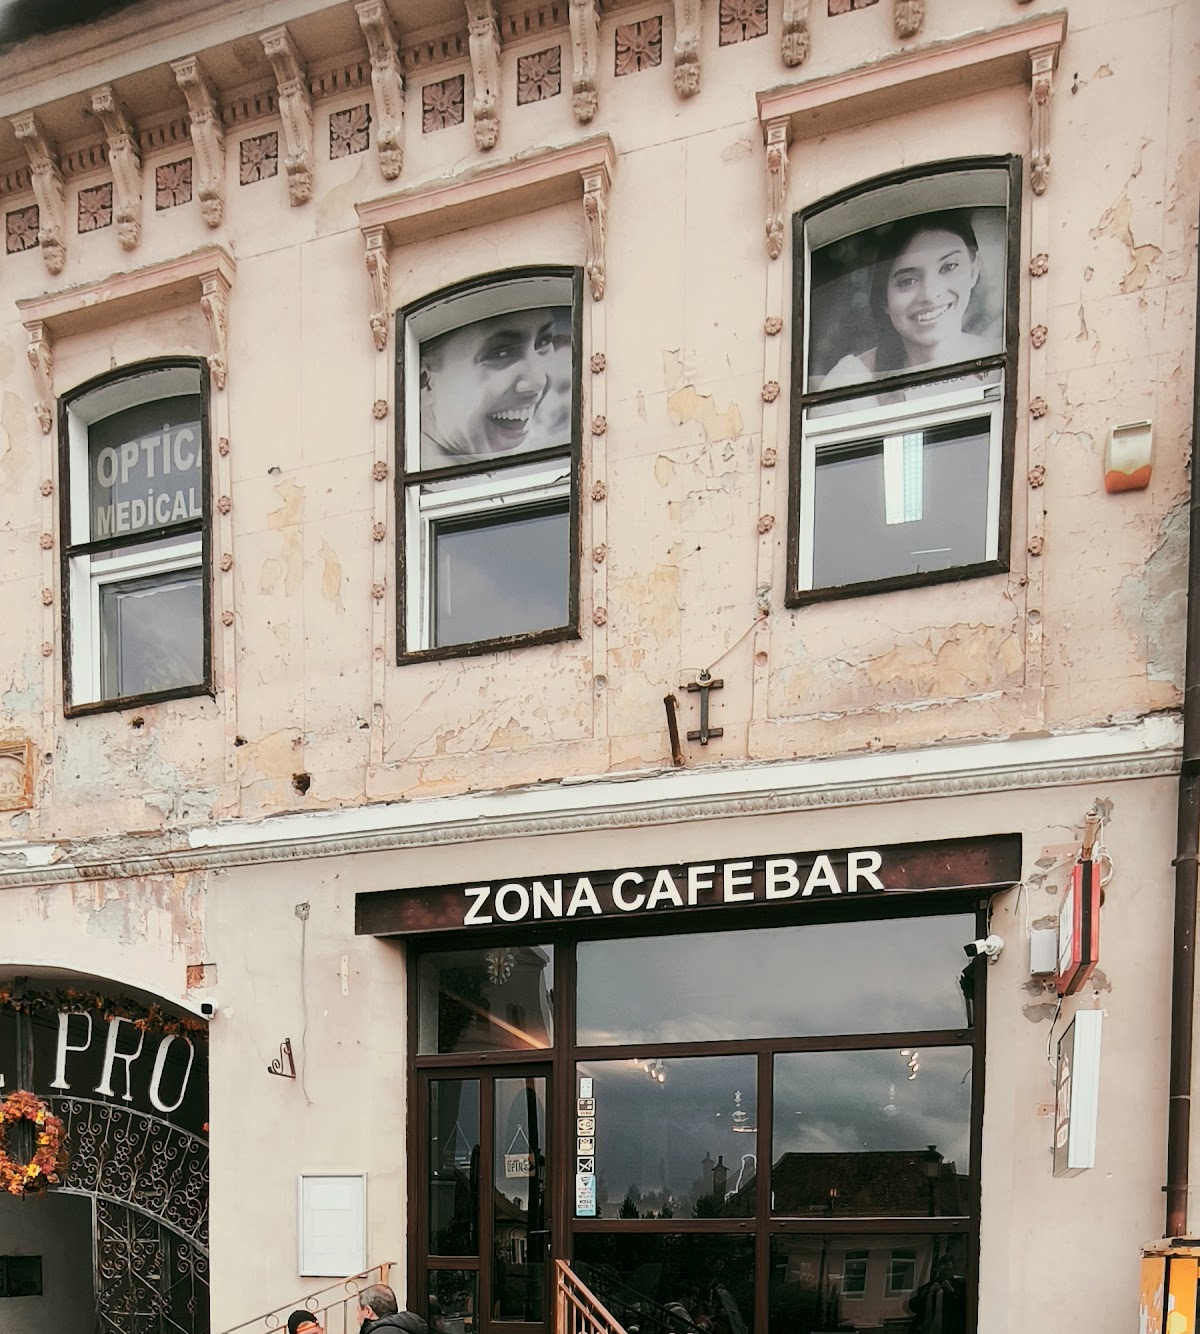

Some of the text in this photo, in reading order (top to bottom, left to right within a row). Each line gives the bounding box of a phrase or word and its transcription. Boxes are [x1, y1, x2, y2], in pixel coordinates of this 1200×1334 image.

[463, 849, 885, 926] ZONA CAFE BAR
[49, 1008, 195, 1113] PRO
